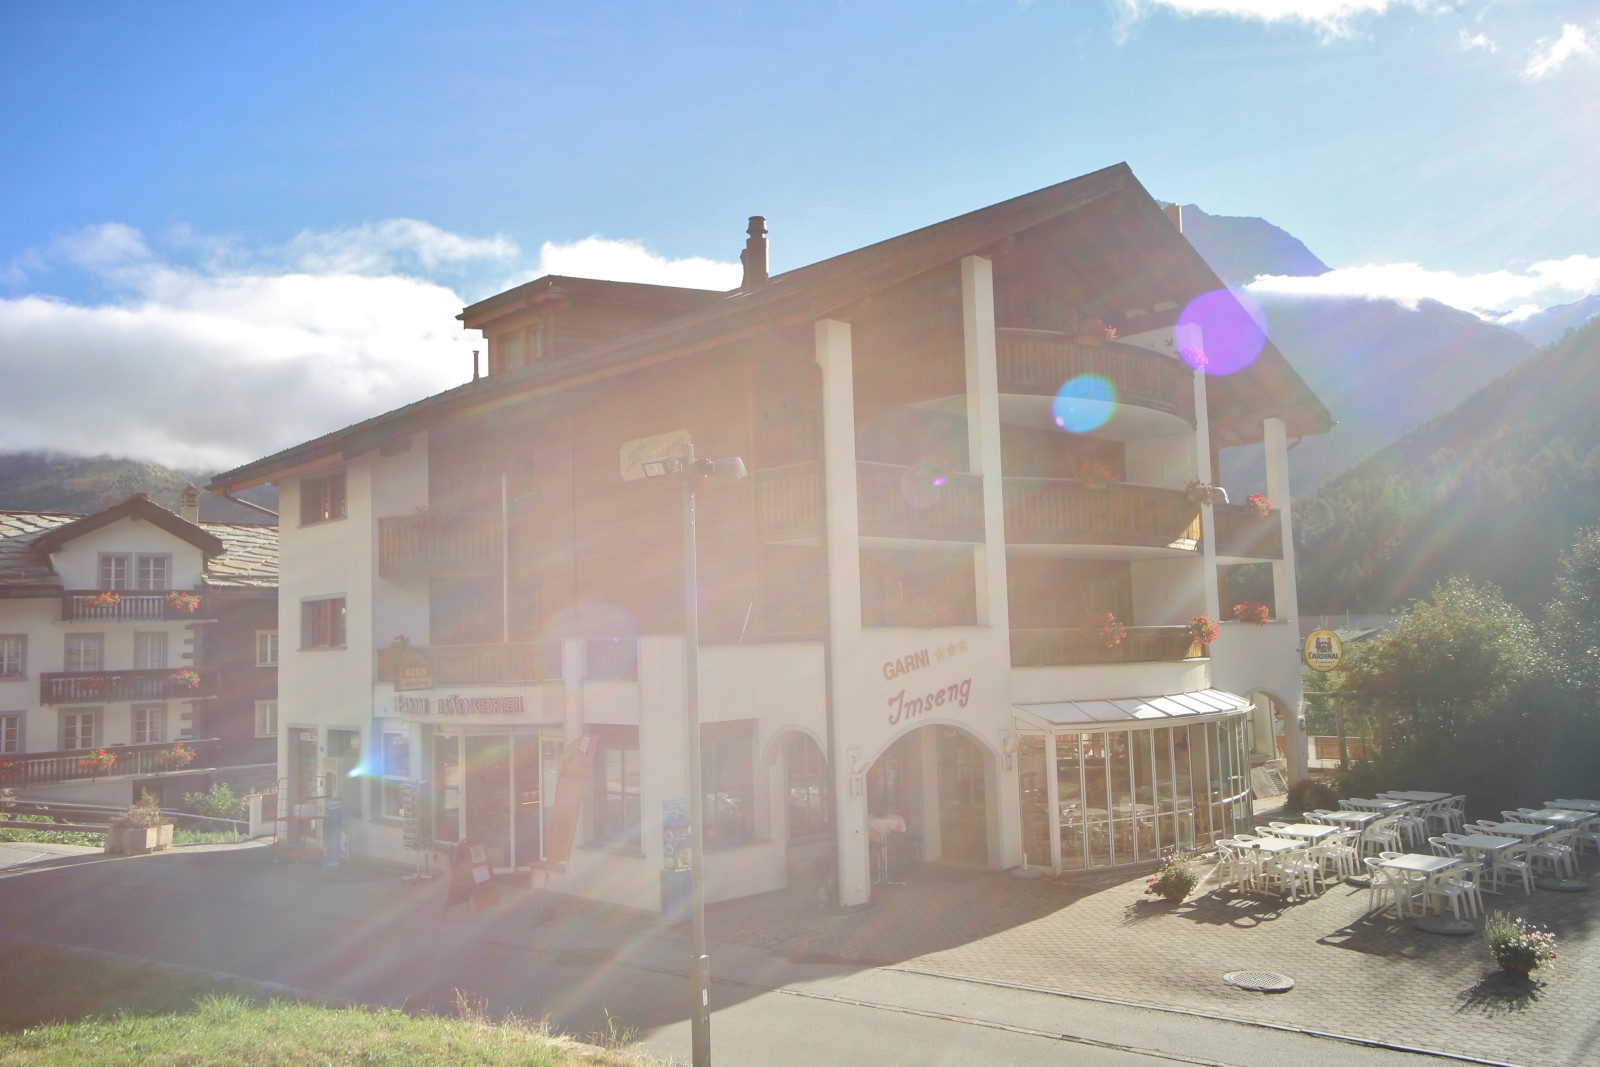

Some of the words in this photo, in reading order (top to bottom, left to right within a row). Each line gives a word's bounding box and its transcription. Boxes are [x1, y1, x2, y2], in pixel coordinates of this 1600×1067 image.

[404, 666, 428, 678] BECK
[883, 648, 930, 680] GARNI
[438, 693, 525, 715] BÄCKEREI
[887, 677, 972, 725] Imseng
